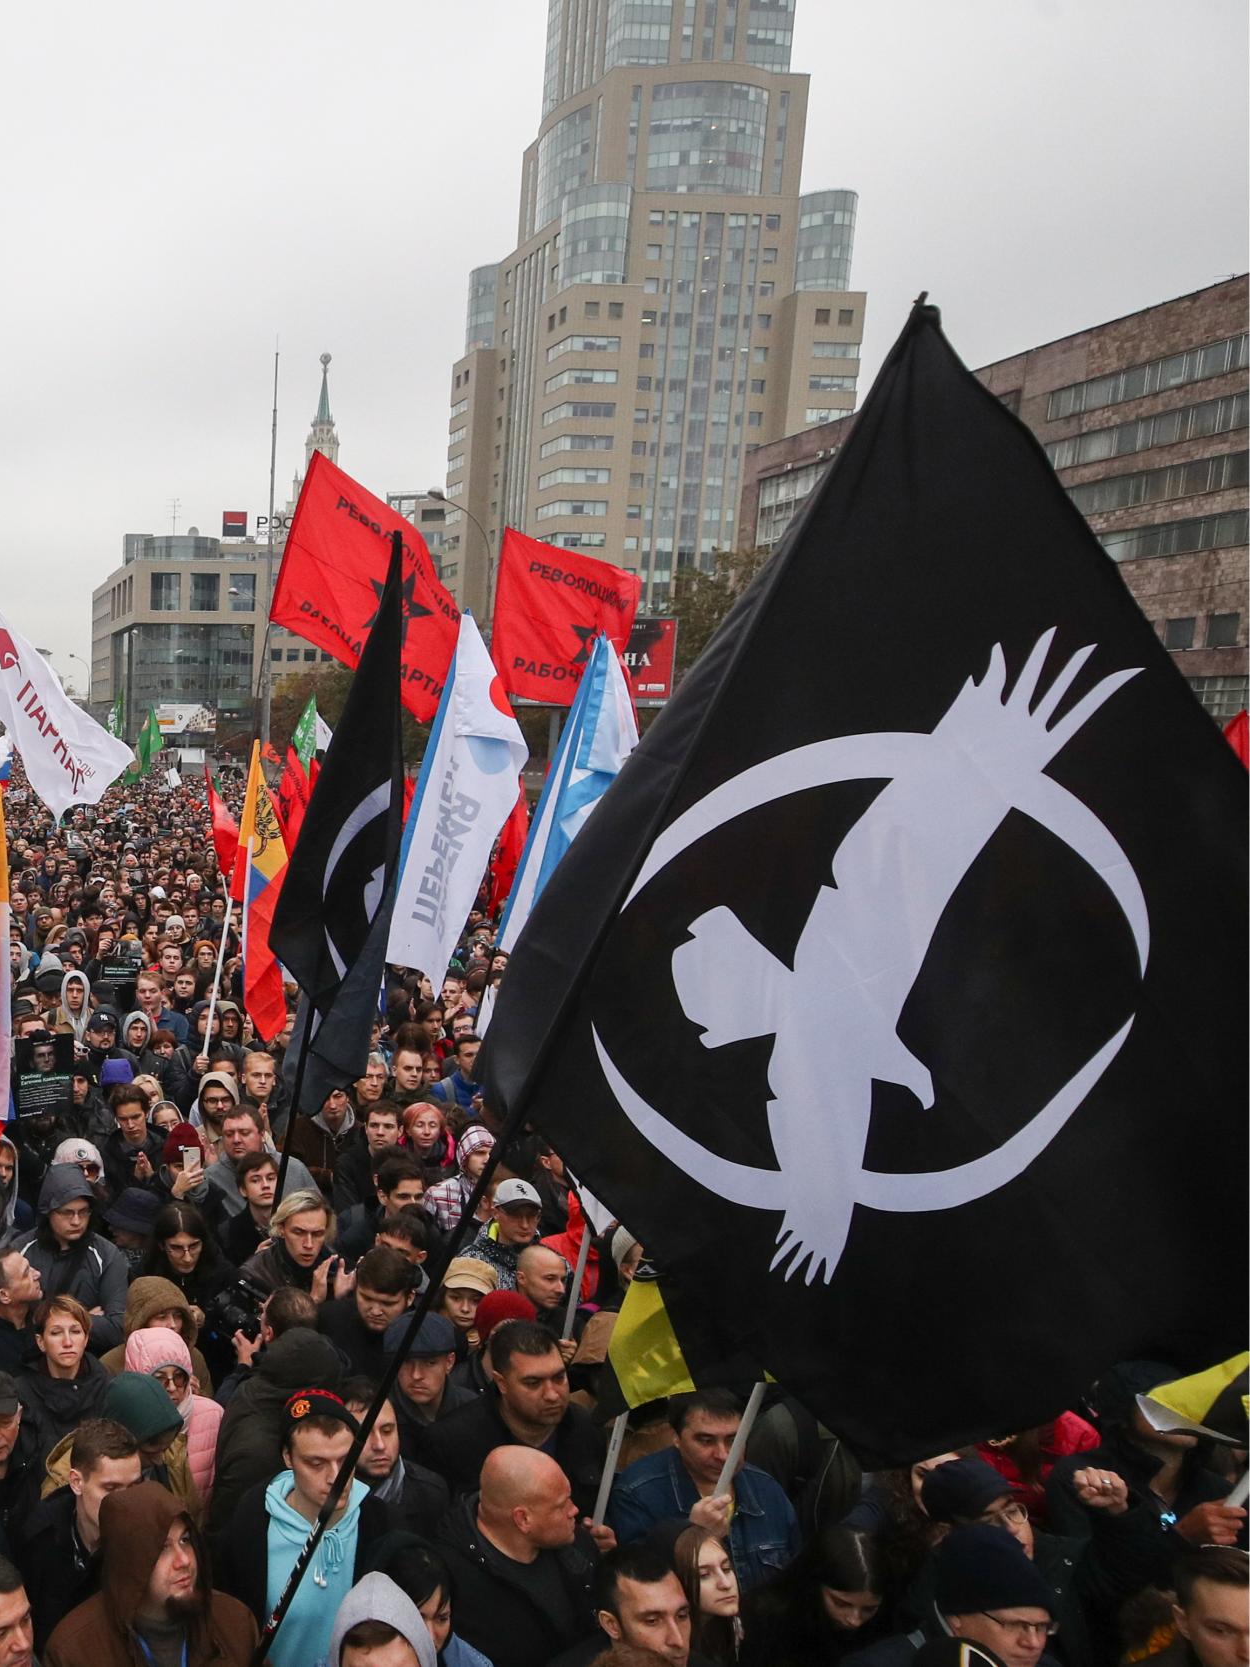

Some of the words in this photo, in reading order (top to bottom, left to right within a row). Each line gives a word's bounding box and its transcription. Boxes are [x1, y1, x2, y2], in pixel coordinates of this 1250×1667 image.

[257, 517, 294, 529] РОС
[400, 664, 445, 697] АРТИ
[513, 657, 581, 683] РАБОЧ
